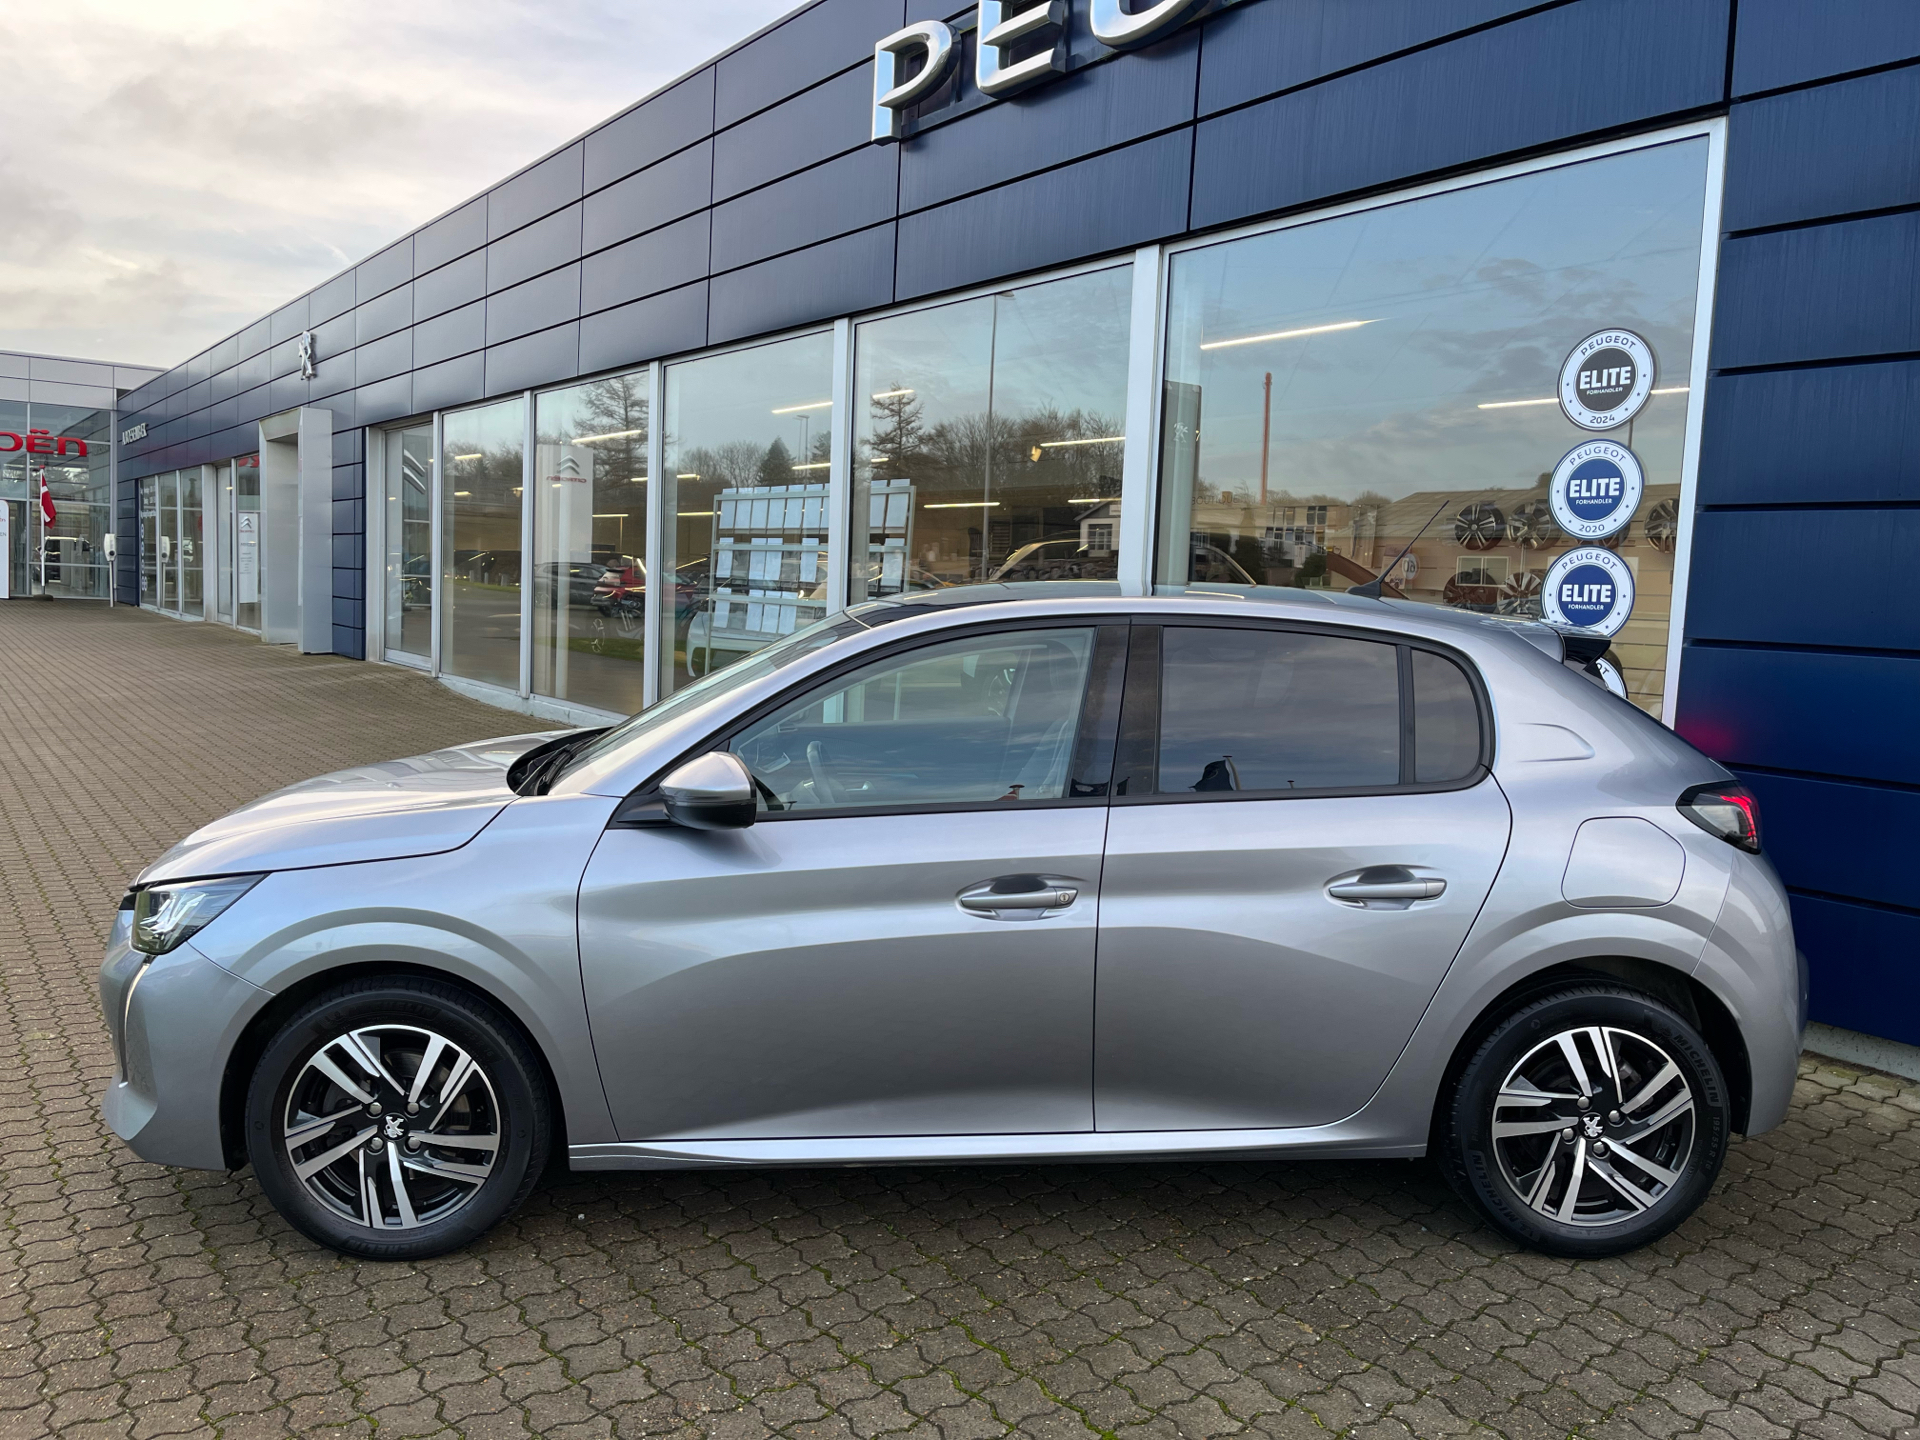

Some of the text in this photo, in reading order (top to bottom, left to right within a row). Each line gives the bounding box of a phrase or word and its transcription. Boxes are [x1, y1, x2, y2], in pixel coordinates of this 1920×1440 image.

[1581, 335, 1636, 356] PEUGEOT
[1580, 366, 1631, 389] ELITE
[1586, 386, 1623, 395] FORHANDLER
[1590, 414, 1615, 424] 2024
[1569, 446, 1627, 465] PEUGEOT
[1569, 478, 1620, 498] ELITE
[1579, 524, 1605, 533] 2020
[1561, 552, 1618, 571] PEUGEOT
[1561, 584, 1612, 603] ELITE
[1673, 1035, 1720, 1103] MICHELIN
[1711, 1116, 1721, 1149] 195/55
[1472, 1154, 1517, 1223] MICHELIN
